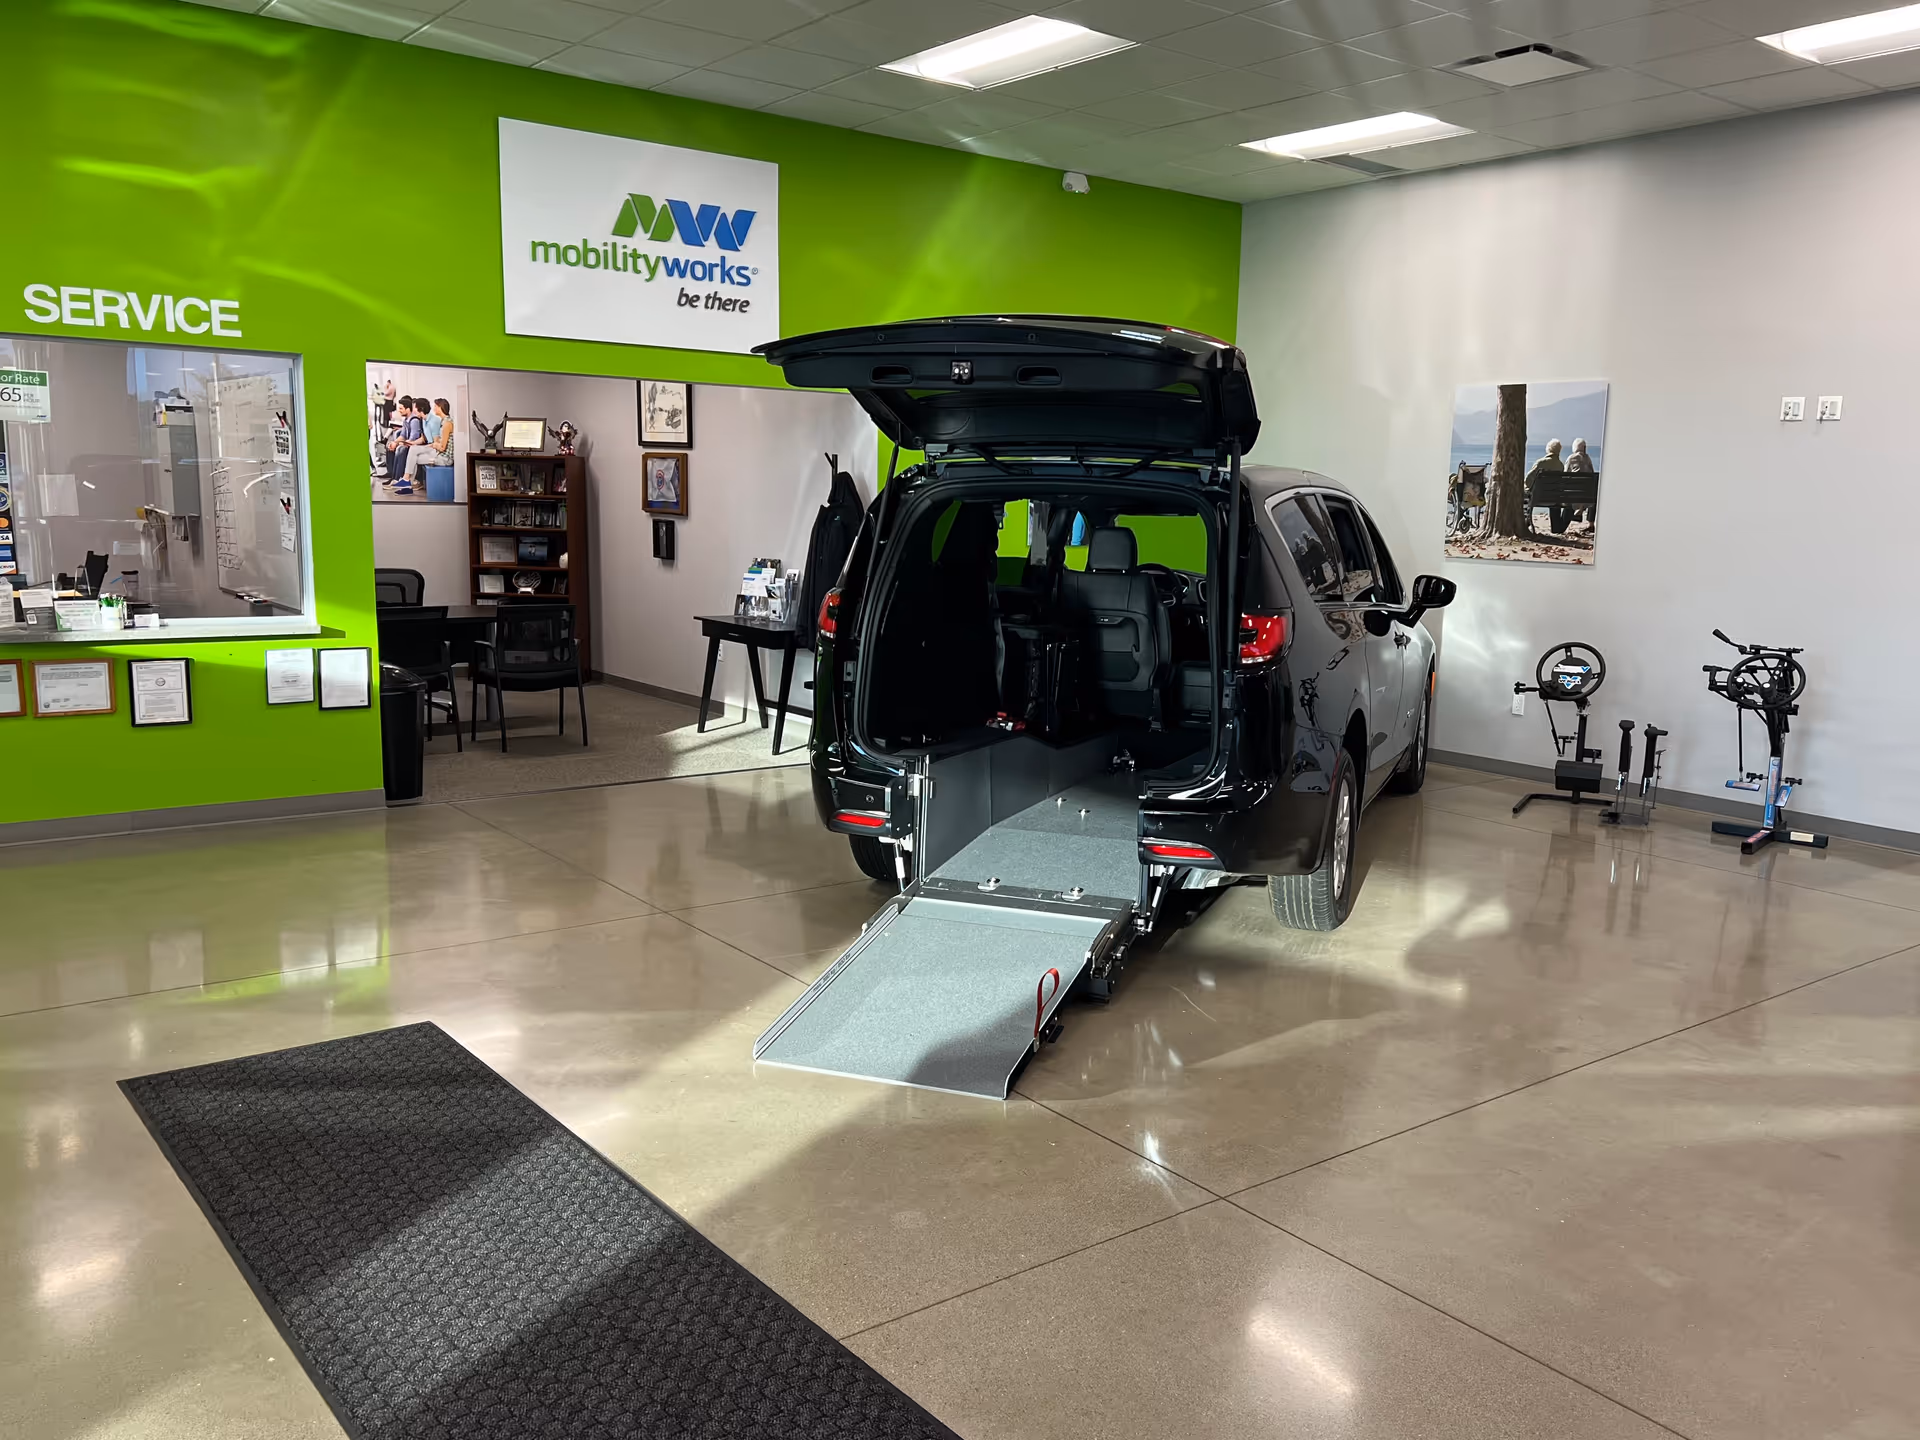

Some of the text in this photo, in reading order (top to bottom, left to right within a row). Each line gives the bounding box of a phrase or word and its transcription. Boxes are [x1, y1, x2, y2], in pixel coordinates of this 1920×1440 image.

[24, 284, 242, 337] SERVICE
[677, 287, 750, 314] be there
[15, 373, 40, 384] Rate
